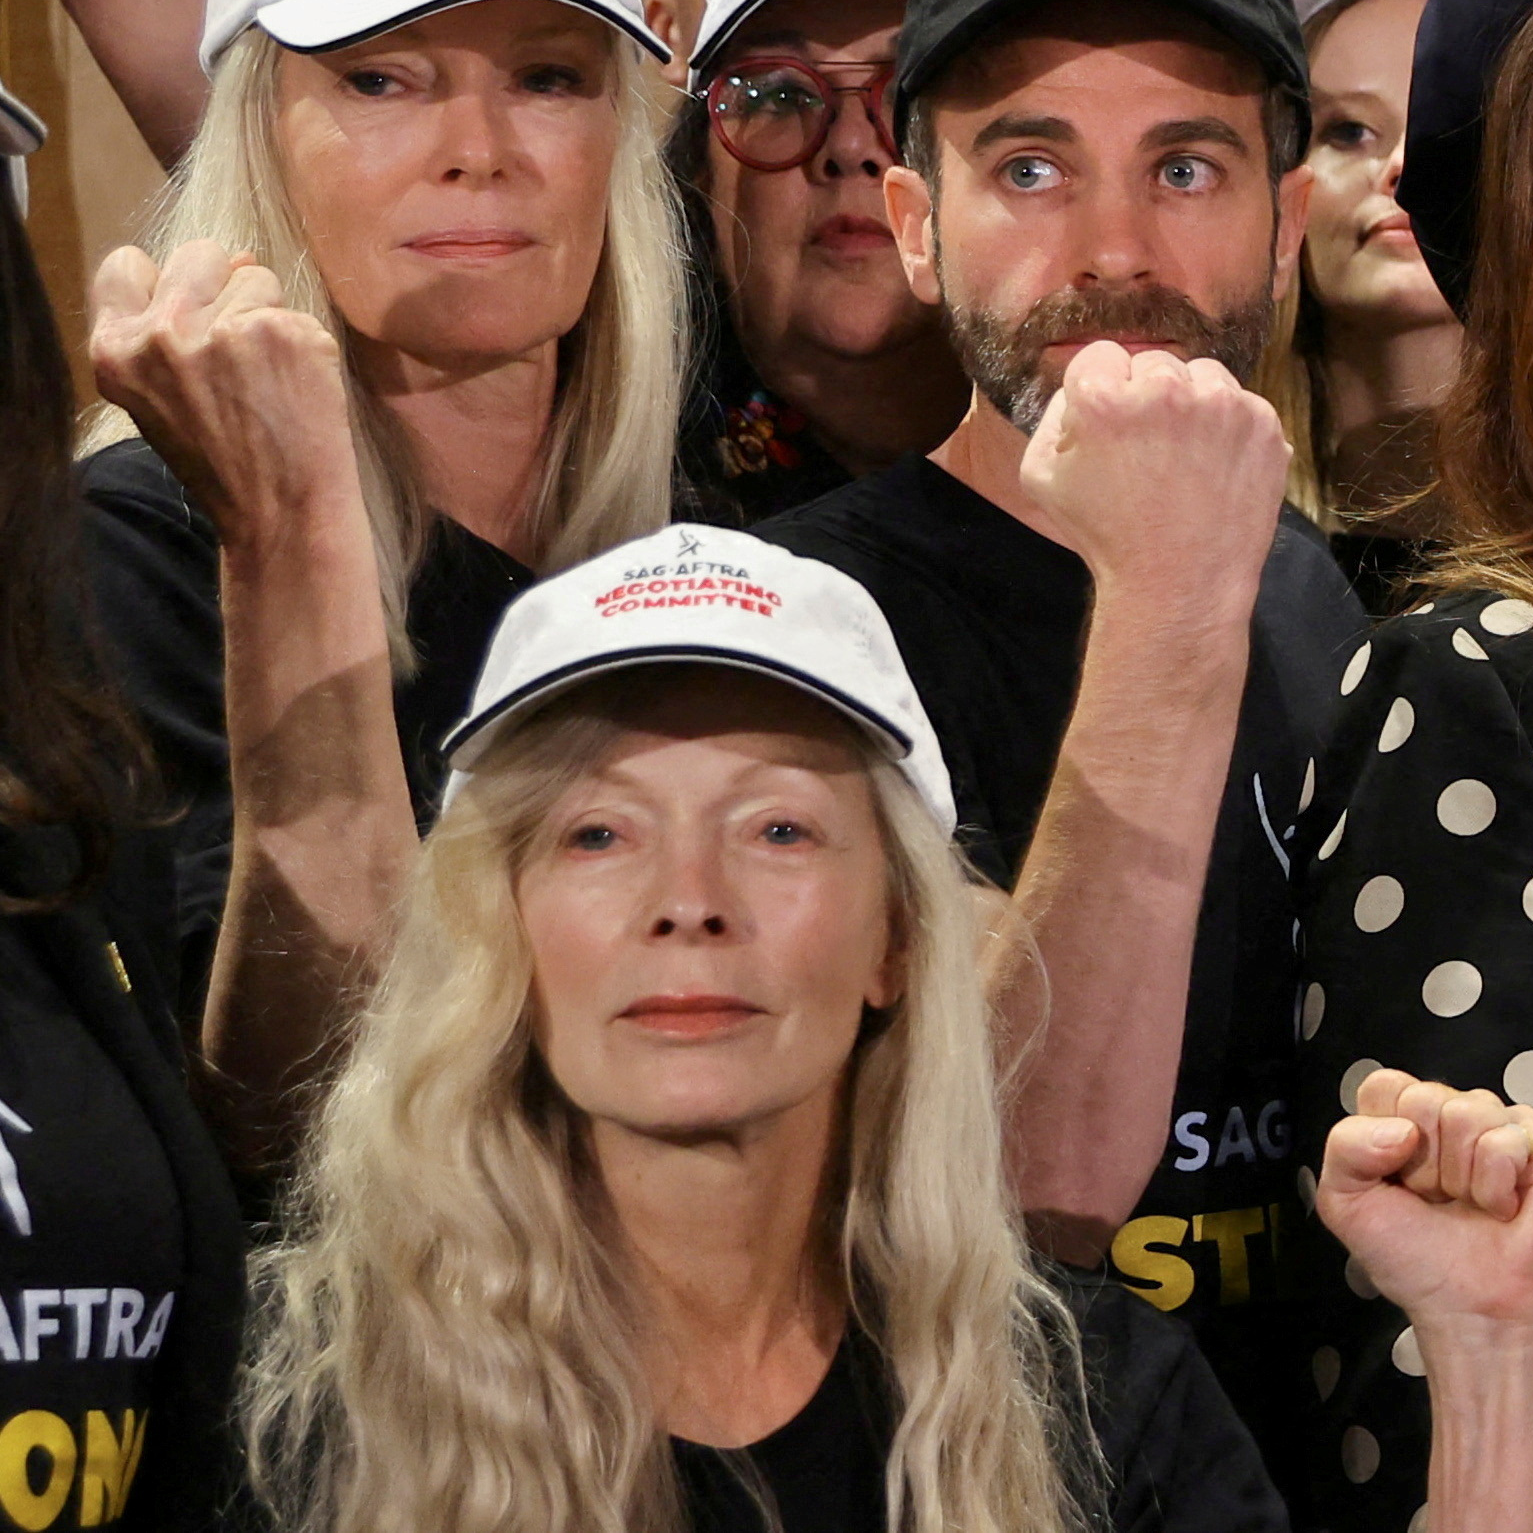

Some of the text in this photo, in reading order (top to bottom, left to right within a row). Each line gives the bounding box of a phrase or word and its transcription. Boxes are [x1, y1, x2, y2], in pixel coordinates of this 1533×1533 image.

[623, 562, 750, 582] SAG·AFTRA
[594, 577, 783, 609] NEGOTIATING
[600, 592, 775, 619] COMMITTEE
[1111, 1203, 1282, 1312] ST
